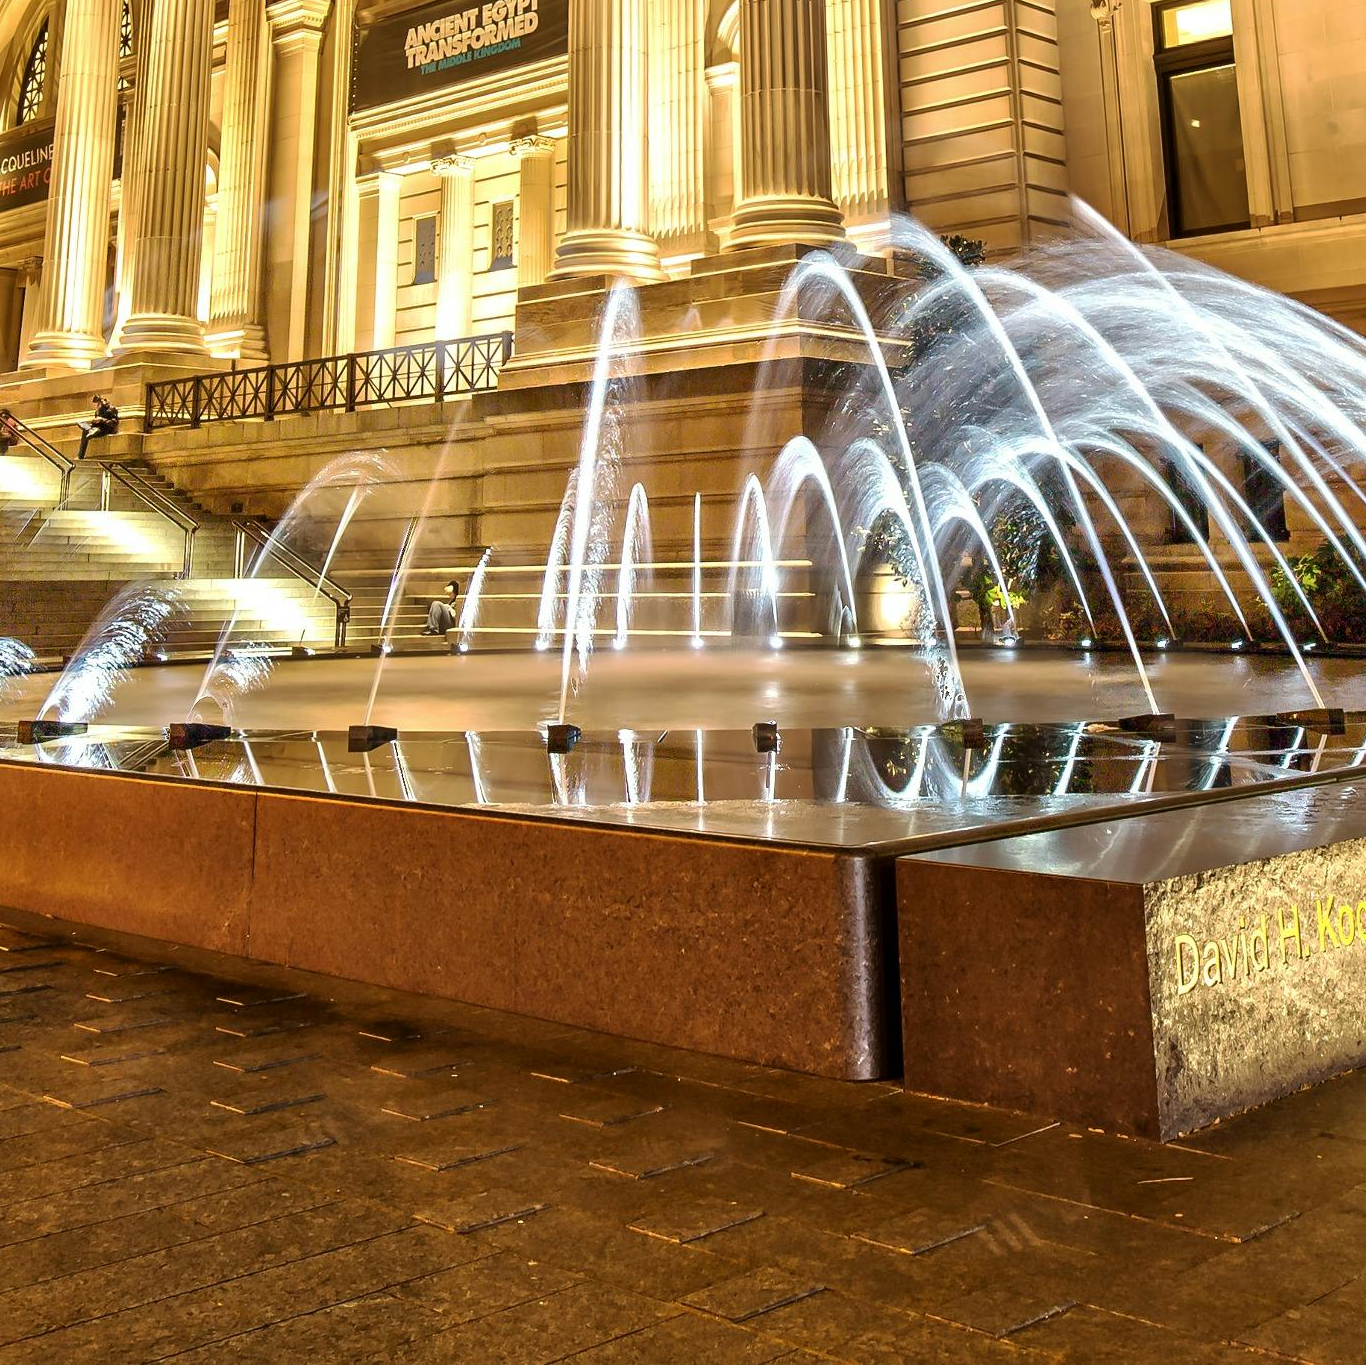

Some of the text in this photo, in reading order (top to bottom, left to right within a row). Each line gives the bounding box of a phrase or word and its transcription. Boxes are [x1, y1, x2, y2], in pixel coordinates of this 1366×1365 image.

[404, 8, 479, 50] ANCIENT
[406, 12, 539, 69] TRANSFORMED
[420, 38, 521, 75] THE MIDDLE KINGDOM
[19, 170, 41, 192] ART
[1175, 913, 1271, 995] David
[1278, 903, 1311, 964] H.
